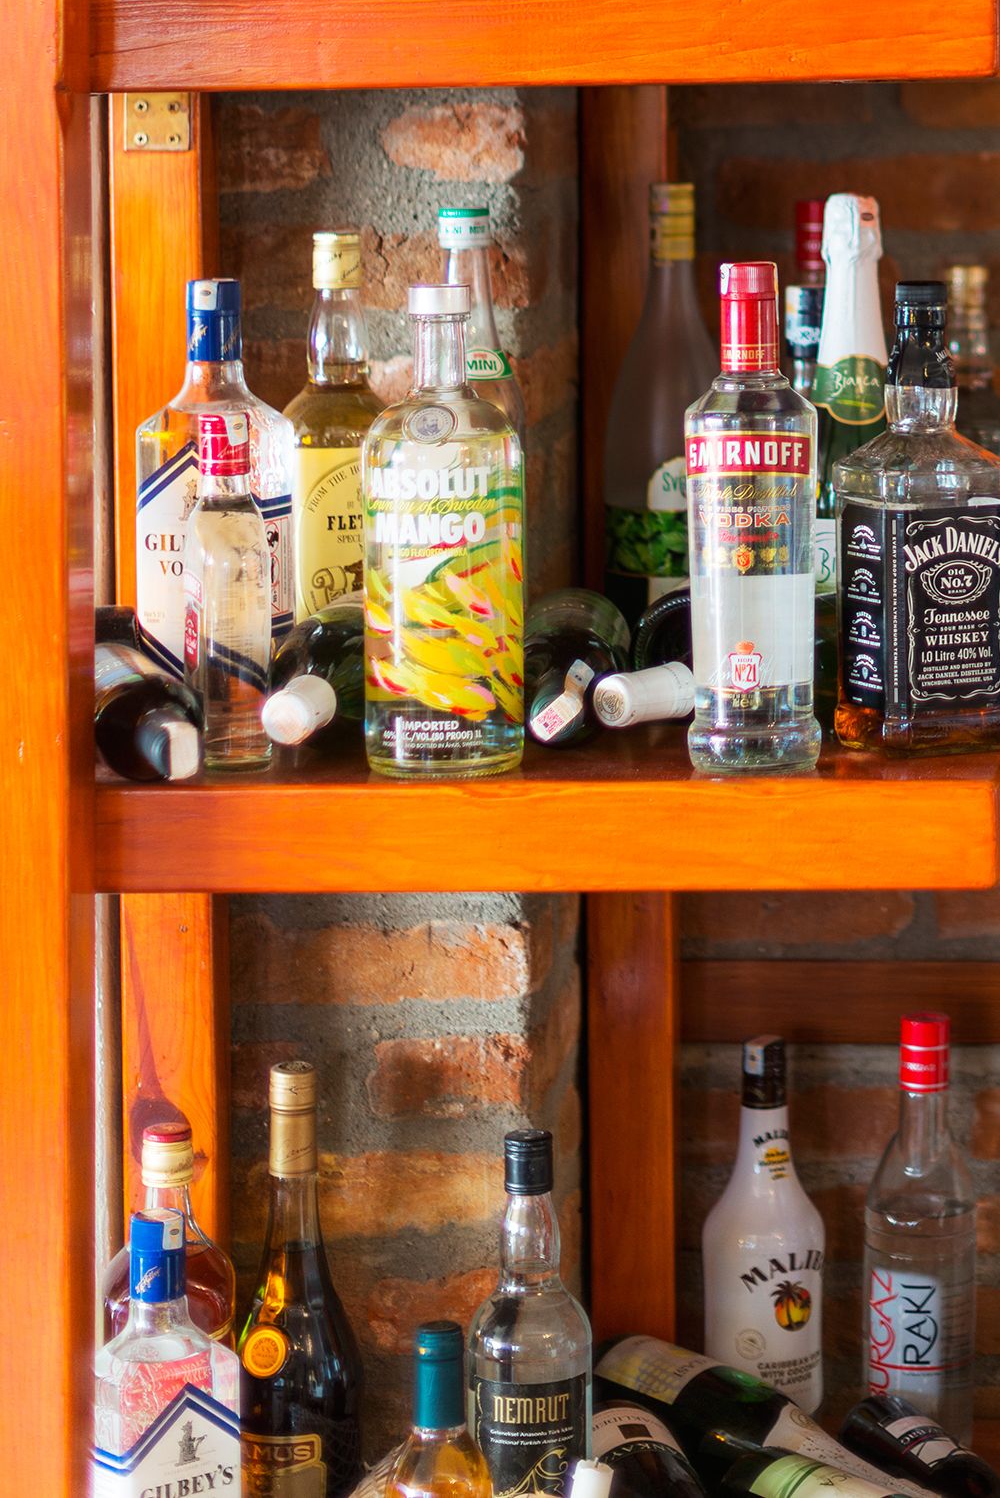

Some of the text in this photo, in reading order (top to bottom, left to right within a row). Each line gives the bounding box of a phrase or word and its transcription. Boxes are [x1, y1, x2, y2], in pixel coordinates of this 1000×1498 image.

[723, 349, 766, 360] SMIRNOFF
[466, 358, 498, 371] MINI
[689, 440, 803, 469] SMIRNOFF
[372, 465, 491, 500] ABSOLUT
[307, 487, 329, 514] FROM
[435, 494, 496, 515] Sweden
[375, 511, 486, 545] MANGO
[699, 511, 792, 528] VODKA
[145, 533, 185, 552] GIL
[903, 535, 946, 572] JACK
[940, 574, 974, 590] No.7
[923, 608, 990, 624] Tennessee
[925, 630, 990, 647] WHISKEY
[934, 649, 956, 663] Litre
[957, 647, 977, 661] 40%
[978, 646, 994, 658] Vol.
[917, 667, 997, 681] JACK DANIEL DISTILLERY
[922, 664, 948, 673] DISTILLED
[949, 662, 960, 670] AND
[400, 720, 460, 731] IMPORTED
[445, 731, 474, 741] PROOF)
[901, 1282, 938, 1366] RAKI
[493, 1393, 570, 1424] NEMRUT
[490, 1437, 520, 1446] Traditional
[140, 1463, 234, 1498] GILBEY'S
